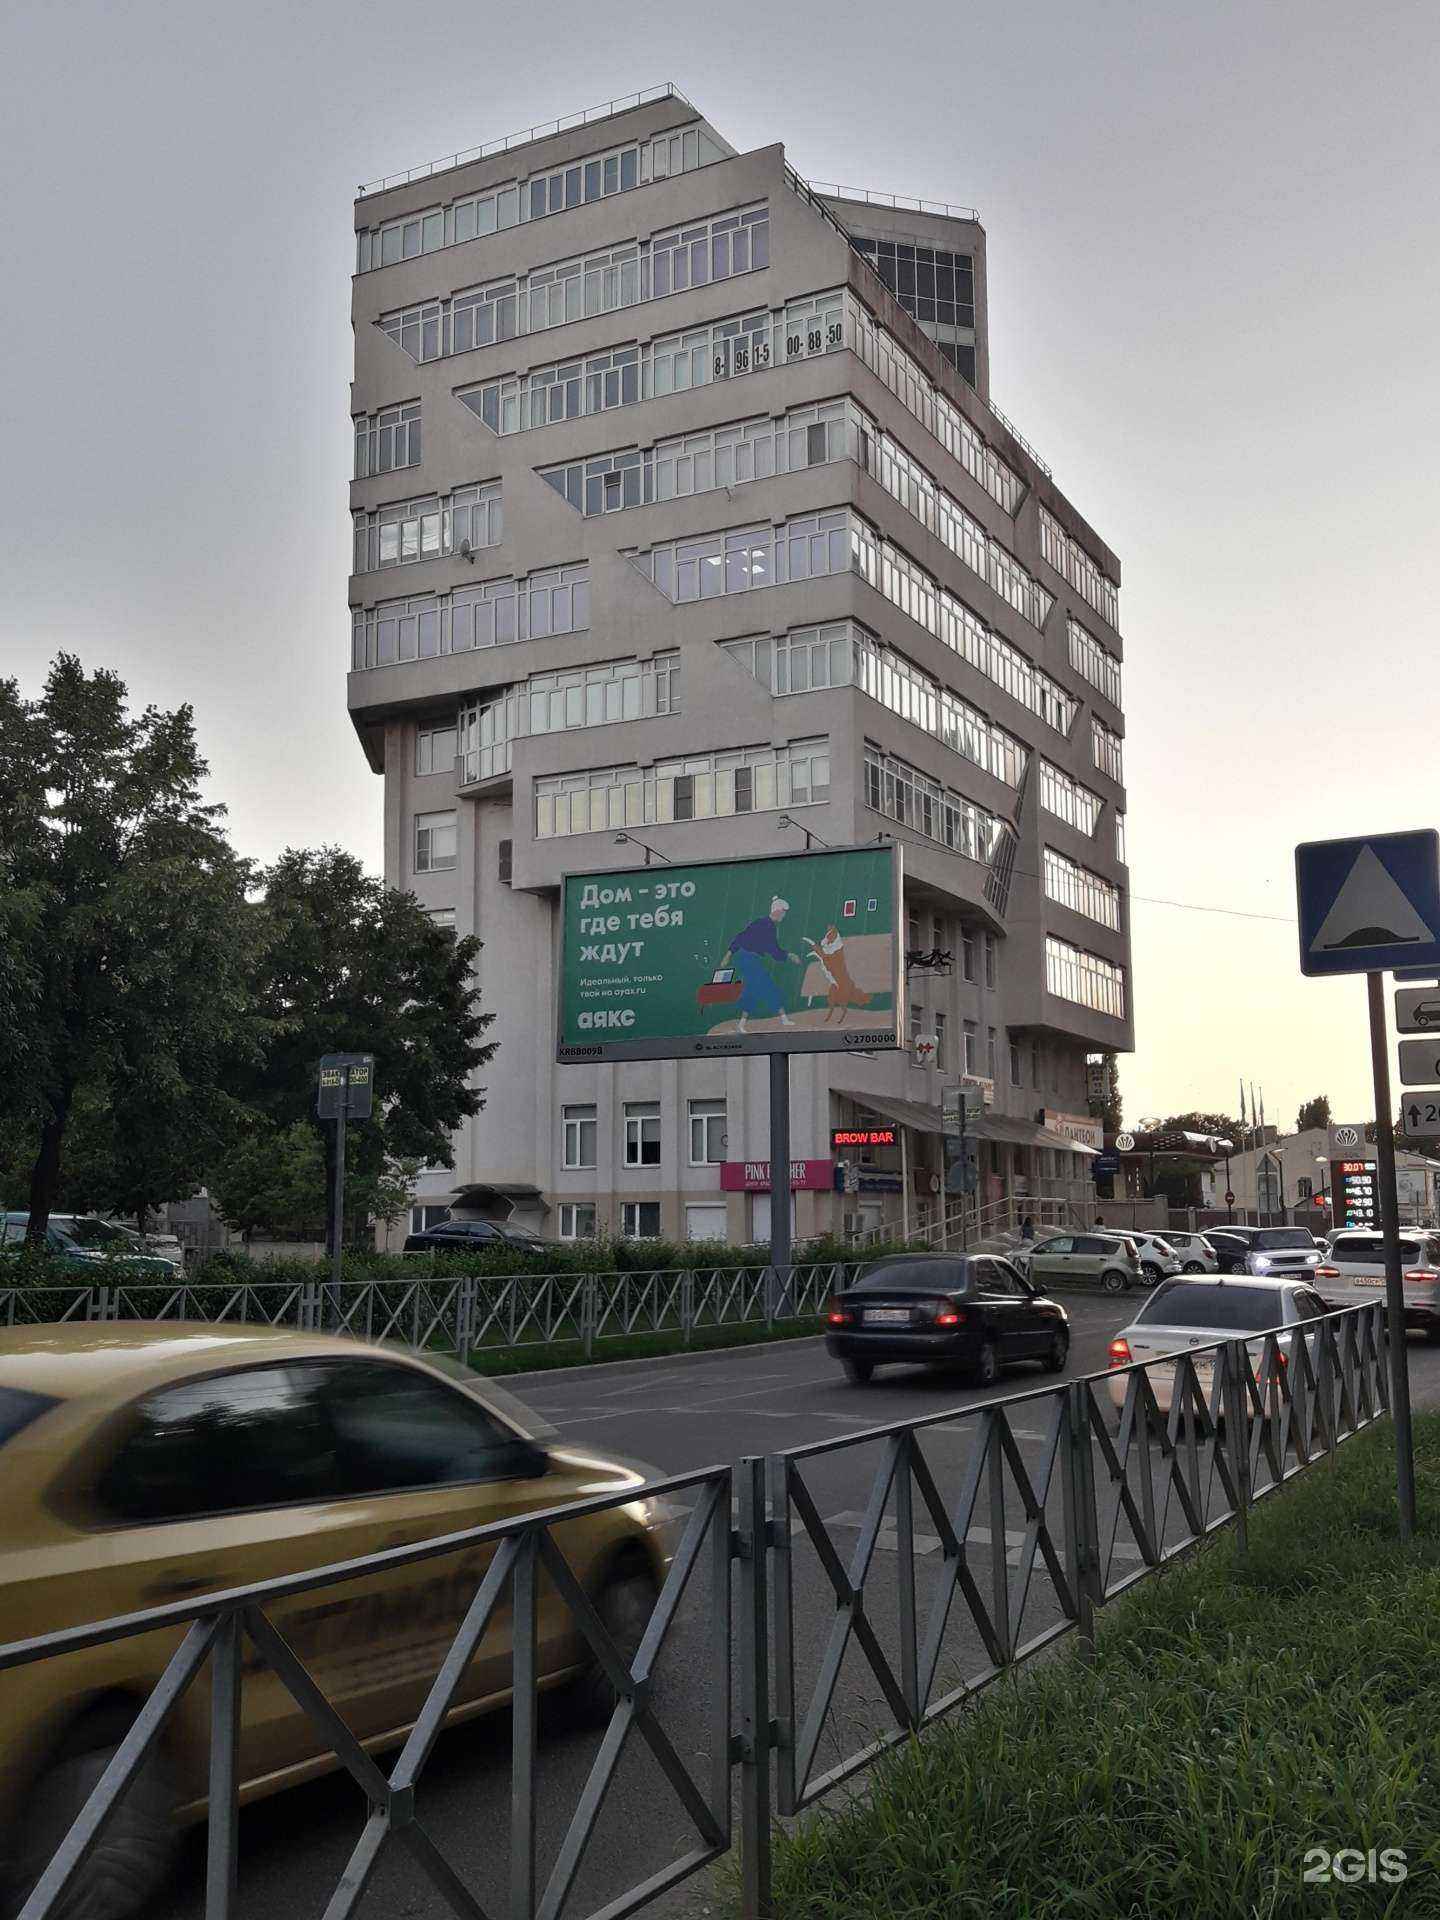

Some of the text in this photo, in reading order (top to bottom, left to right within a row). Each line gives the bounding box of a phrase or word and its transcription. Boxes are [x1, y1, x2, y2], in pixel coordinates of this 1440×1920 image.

[580, 884, 633, 909] Дом
[655, 880, 696, 900] это
[580, 904, 684, 935] где тебя
[579, 941, 645, 964] ждут
[633, 974, 663, 983] только
[577, 1008, 636, 1029] аякс
[854, 1033, 896, 1044] 2700000
[834, 1131, 894, 1144] BROW BAR
[745, 1162, 765, 1180] PINK
